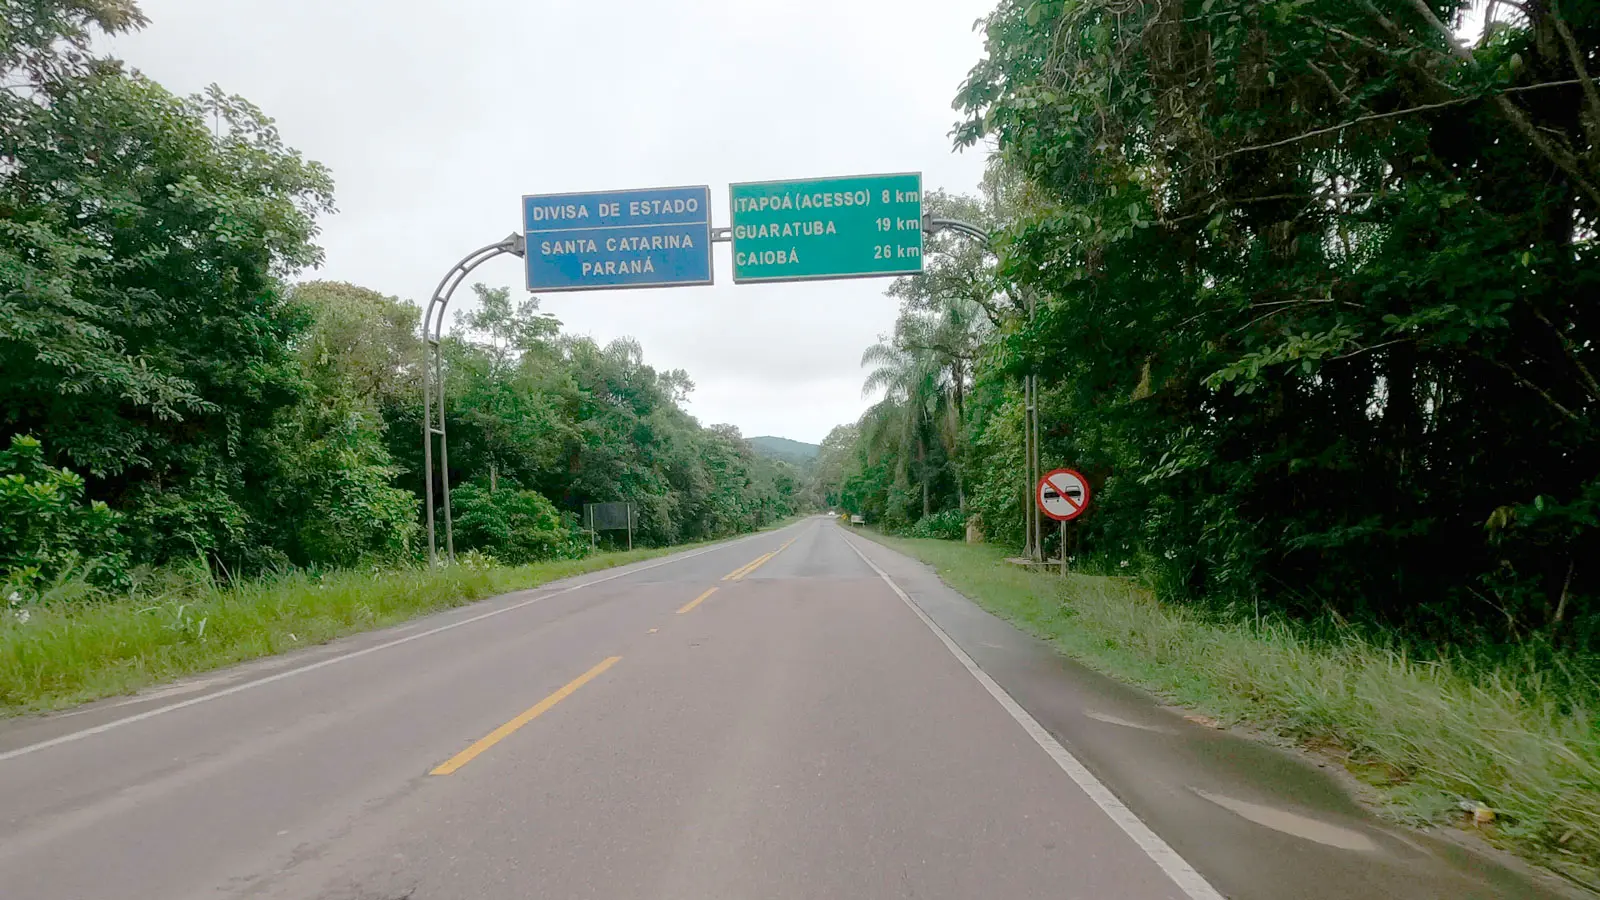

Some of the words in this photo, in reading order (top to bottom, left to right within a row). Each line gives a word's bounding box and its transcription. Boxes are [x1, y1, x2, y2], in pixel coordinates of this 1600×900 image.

[882, 190, 890, 204] 8
[896, 190, 918, 203] km
[533, 204, 589, 221] DIVISA
[599, 203, 620, 217] DE
[630, 198, 698, 216] ESTADO
[735, 220, 837, 240] GUARATUBA
[875, 218, 891, 232] 19
[897, 218, 919, 231] km
[541, 239, 597, 255] SANTA
[606, 234, 693, 252] CATARINA
[736, 246, 799, 266] CAIOBÁ
[874, 244, 892, 260] 26
[897, 244, 920, 258] km
[582, 256, 654, 276] PARANÁ
